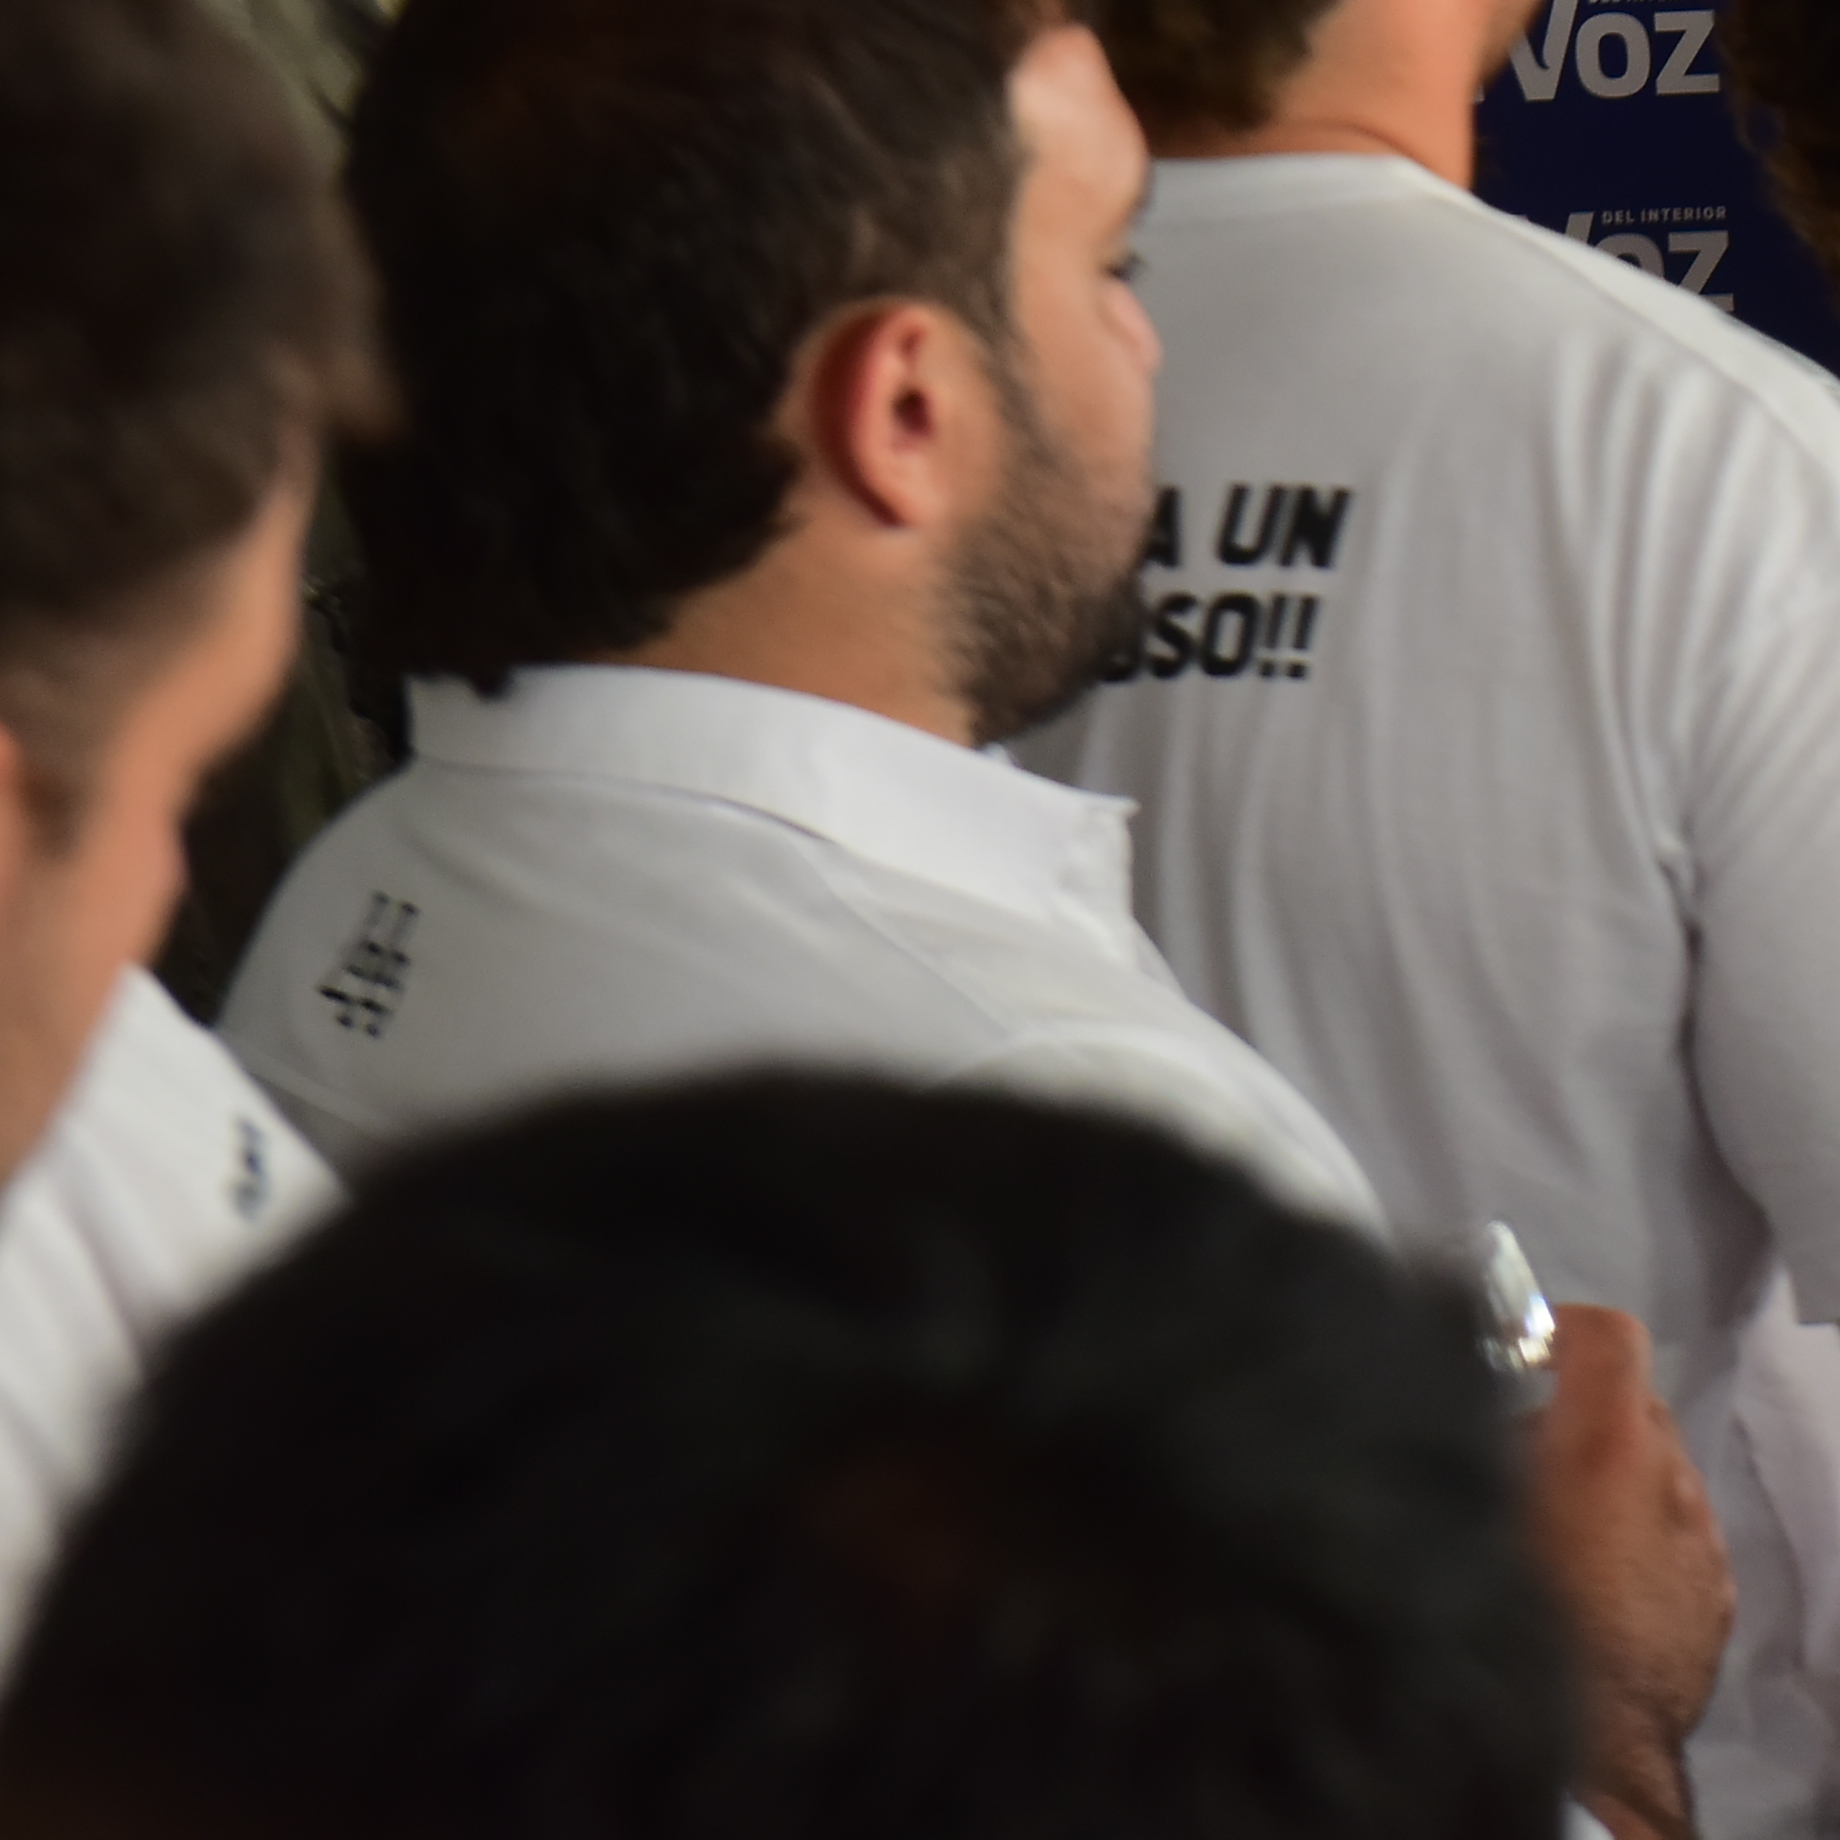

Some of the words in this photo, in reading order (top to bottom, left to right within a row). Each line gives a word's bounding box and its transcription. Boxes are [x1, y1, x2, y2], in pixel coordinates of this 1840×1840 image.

[1602, 210, 1637, 225] DEL
[1641, 205, 1727, 222] INTERIOR
[1217, 484, 1351, 567] UN
